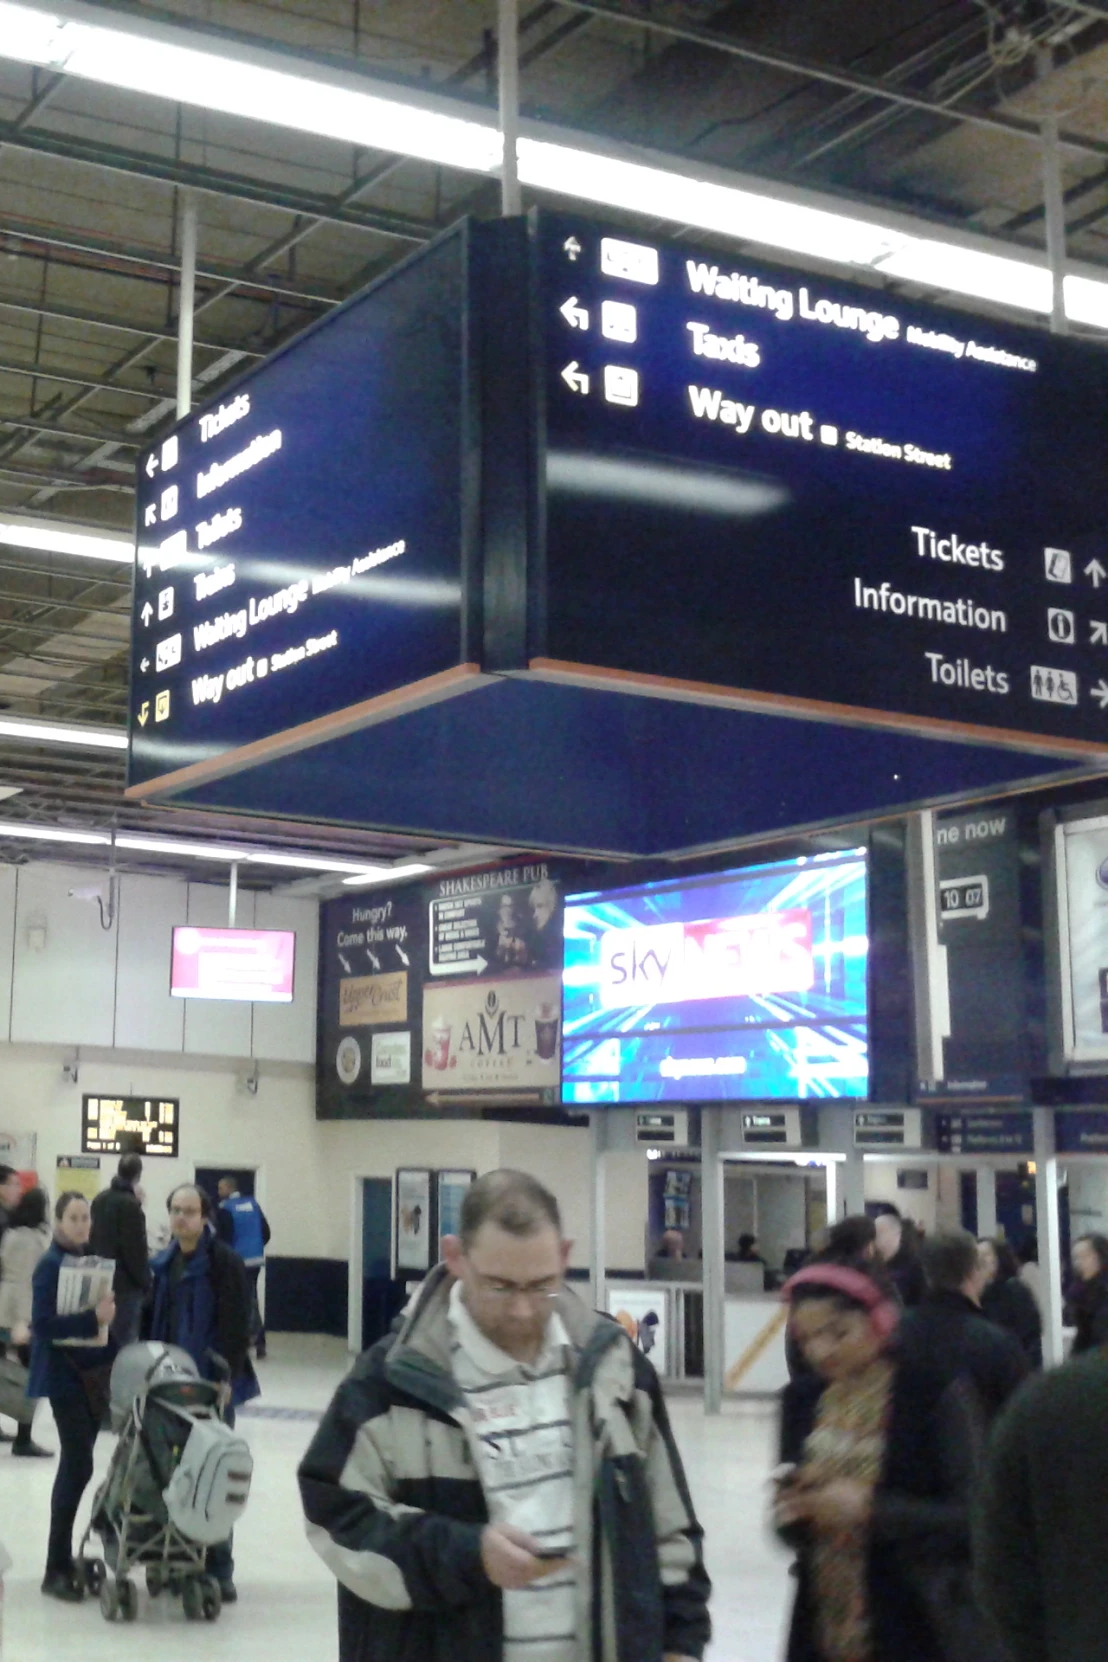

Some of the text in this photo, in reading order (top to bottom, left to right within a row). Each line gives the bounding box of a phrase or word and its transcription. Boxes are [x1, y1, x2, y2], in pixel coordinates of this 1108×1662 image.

[687, 260, 794, 320] Waiting
[799, 288, 900, 342] Lounge
[687, 321, 761, 368] Taxis
[689, 386, 953, 471] Way out Station Street
[911, 525, 1005, 572] Tickets
[194, 609, 247, 651] Waiting
[248, 579, 309, 626] Lounge
[853, 577, 1007, 632] Information
[192, 670, 224, 705] Way
[226, 656, 255, 690] out
[924, 652, 1011, 694] Toilets
[965, 817, 1006, 840] now
[439, 863, 550, 897] SHAKESPEARE PUB
[337, 929, 364, 947] Come
[366, 924, 384, 943] this
[353, 900, 392, 925] Hungry?
[610, 938, 672, 988] sky
[458, 1010, 526, 1056] AMT
